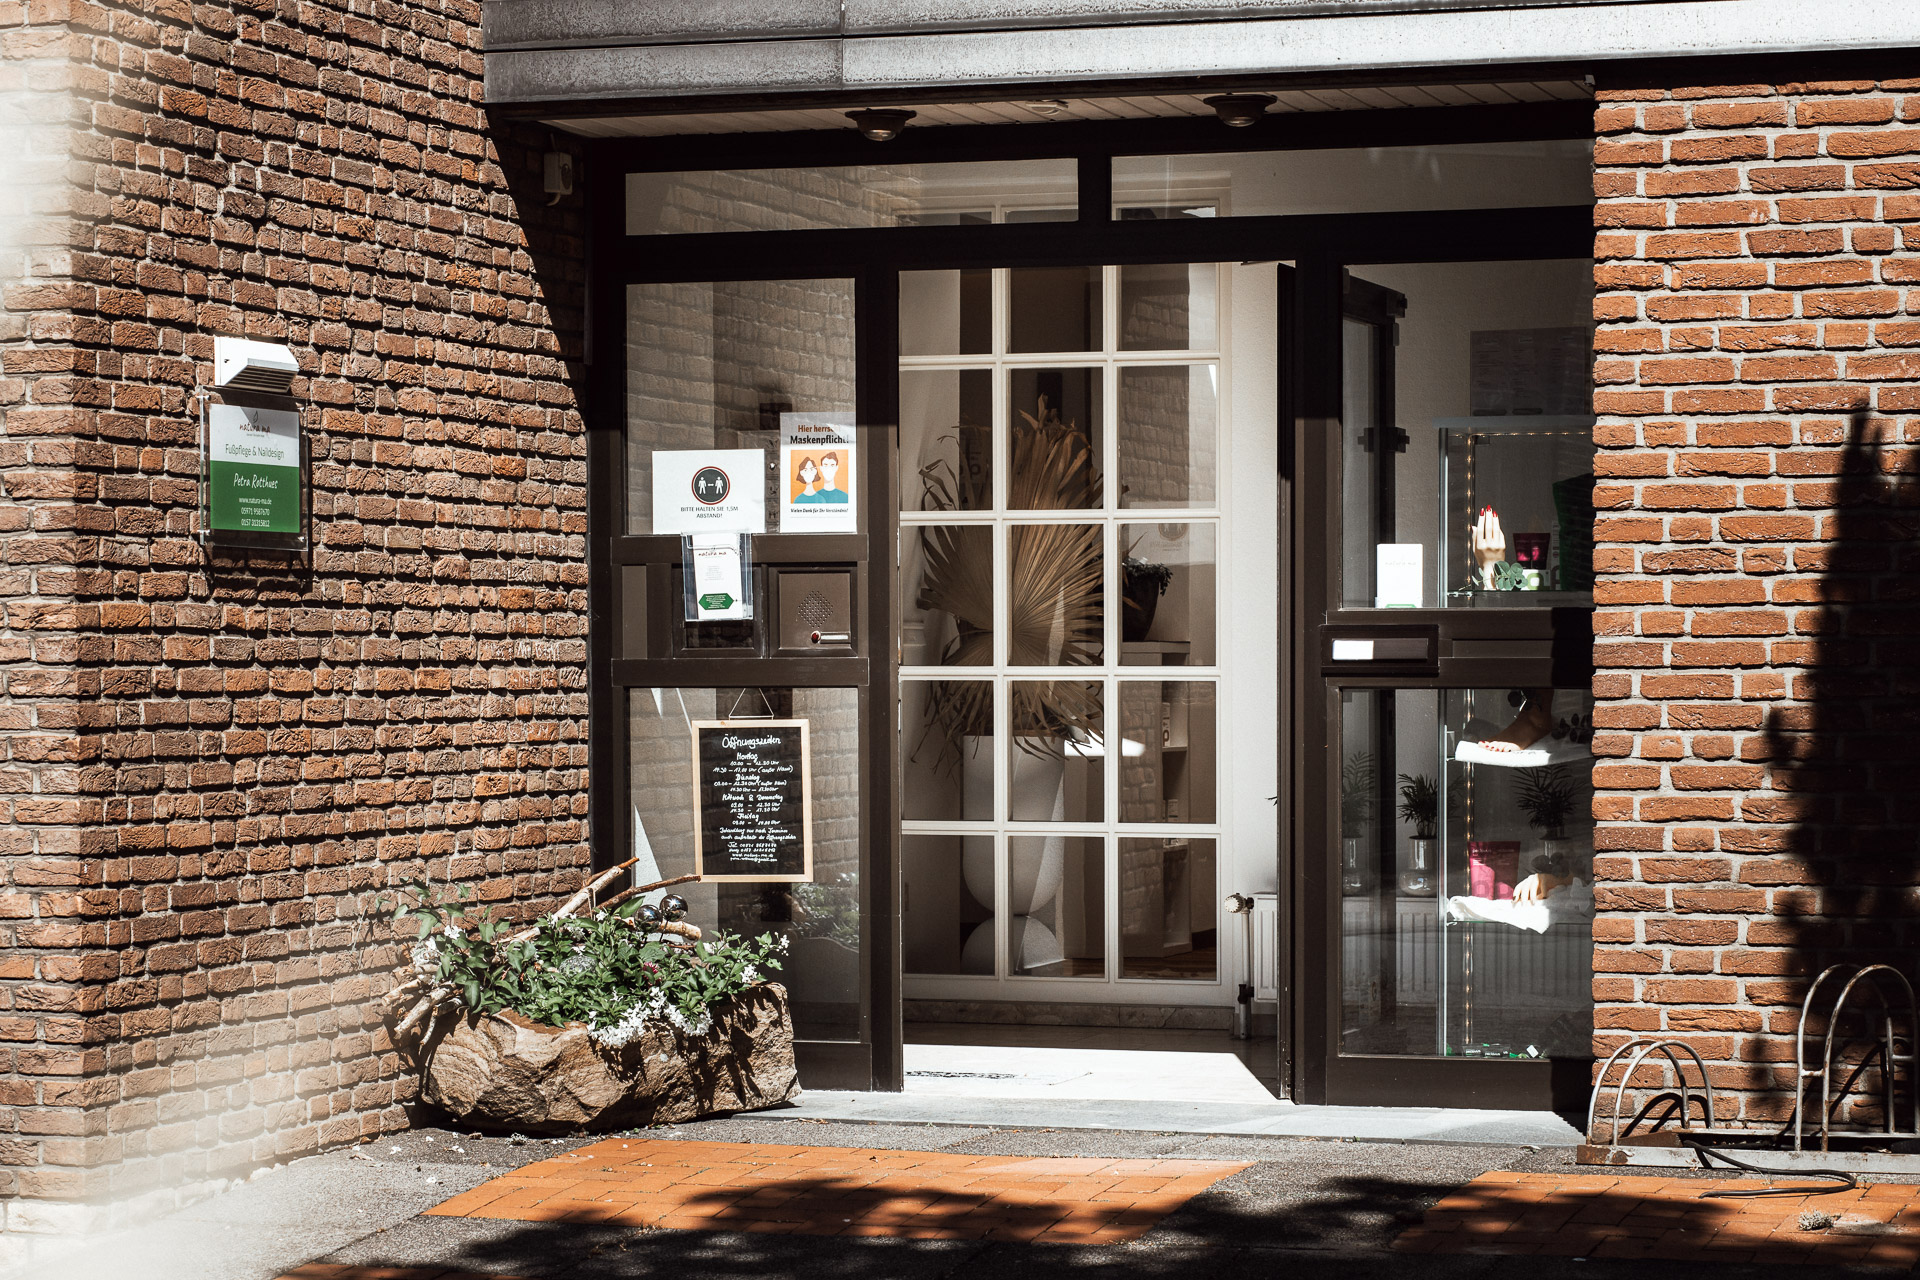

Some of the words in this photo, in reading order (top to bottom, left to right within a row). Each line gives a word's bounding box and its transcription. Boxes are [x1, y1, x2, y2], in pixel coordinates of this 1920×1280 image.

[240, 424, 260, 432] natura
[798, 424, 812, 432] Hier
[790, 434, 849, 446] Maskenpflicht!
[226, 444, 251, 458] Fußpflege
[252, 447, 256, 456] &
[258, 447, 284, 460] Naildesign
[234, 472, 250, 487] Petra
[252, 474, 278, 488] Rotthues
[722, 733, 781, 750] Öffnungszeiten
[736, 752, 758, 763] Montag
[735, 774, 760, 782] Dienstag
[756, 794, 783, 802] Donnerstag
[737, 813, 759, 822] Freitag
